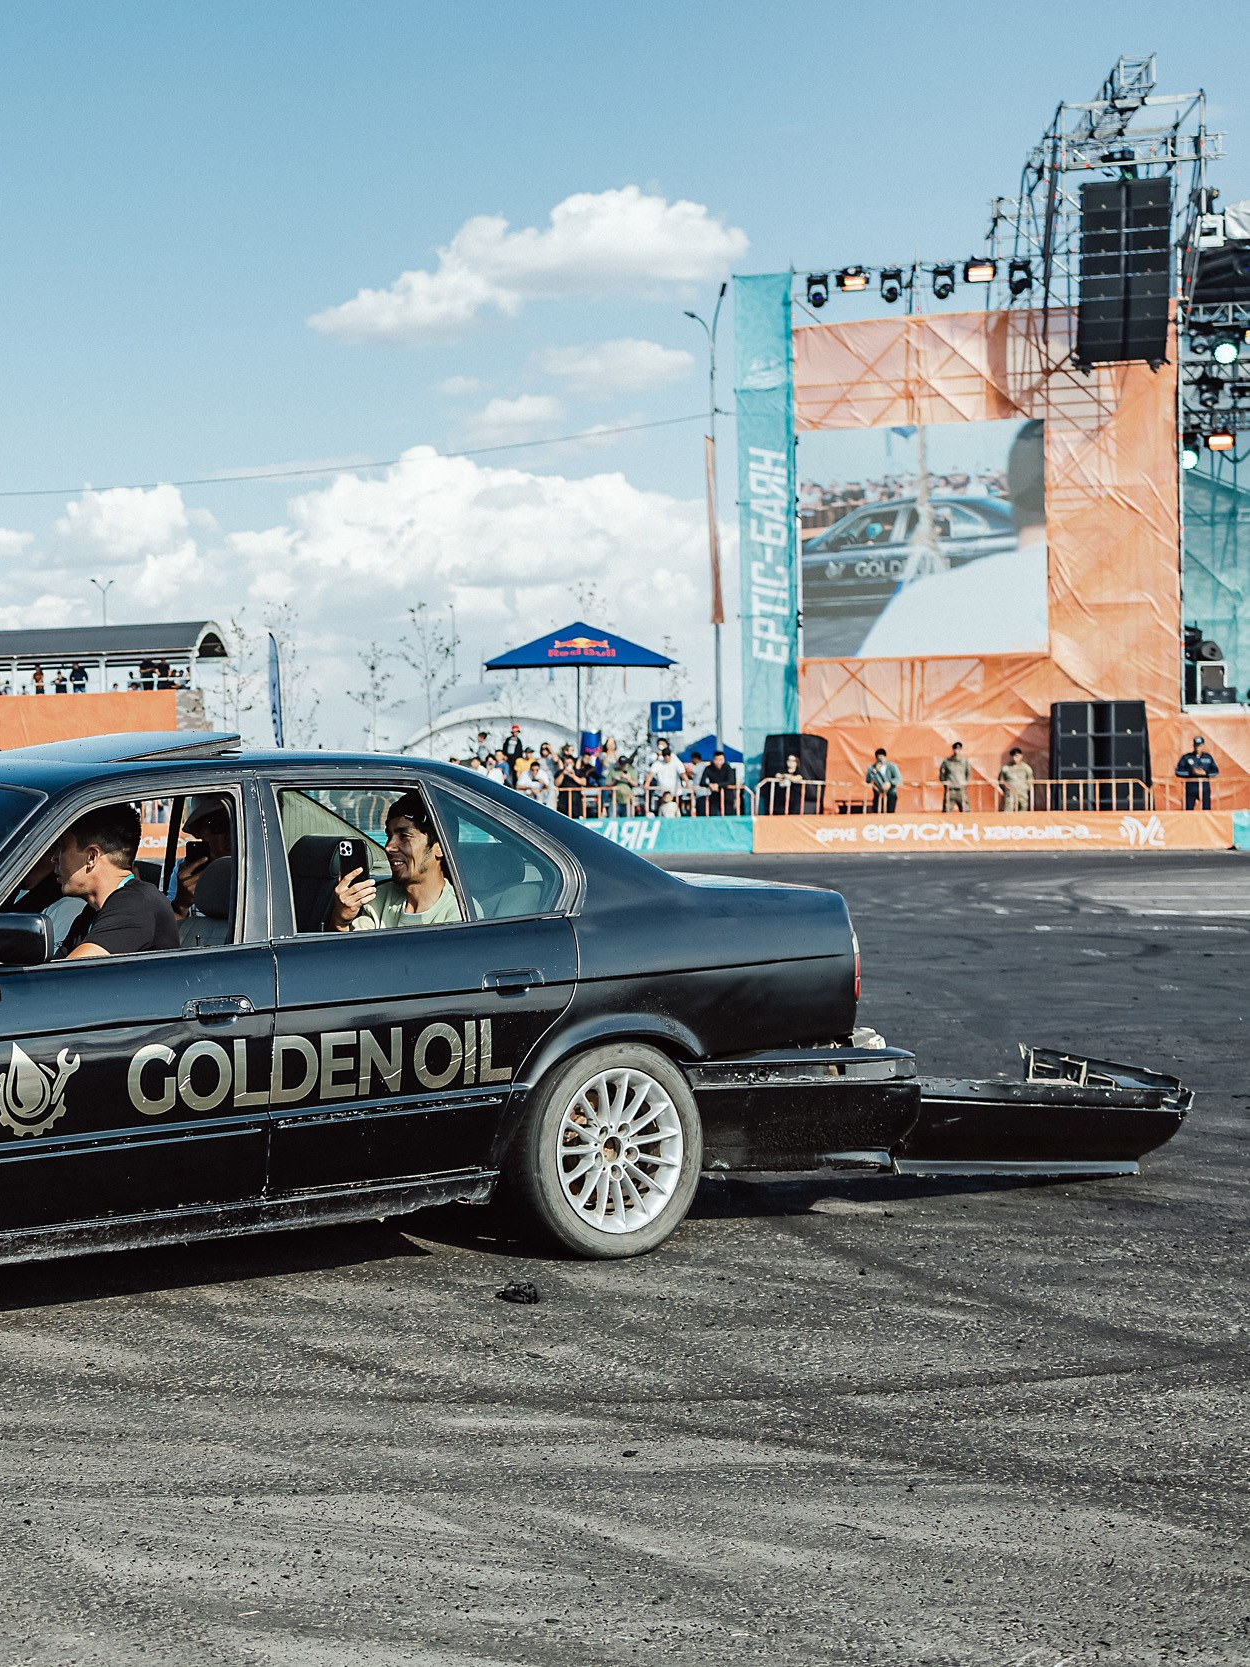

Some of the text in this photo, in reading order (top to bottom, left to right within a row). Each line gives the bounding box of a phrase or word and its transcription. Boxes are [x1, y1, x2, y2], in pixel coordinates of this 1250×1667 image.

[548, 648, 616, 657] Red Bull
[657, 704, 675, 729] P
[127, 1018, 513, 1115] GOLDEN OIL
